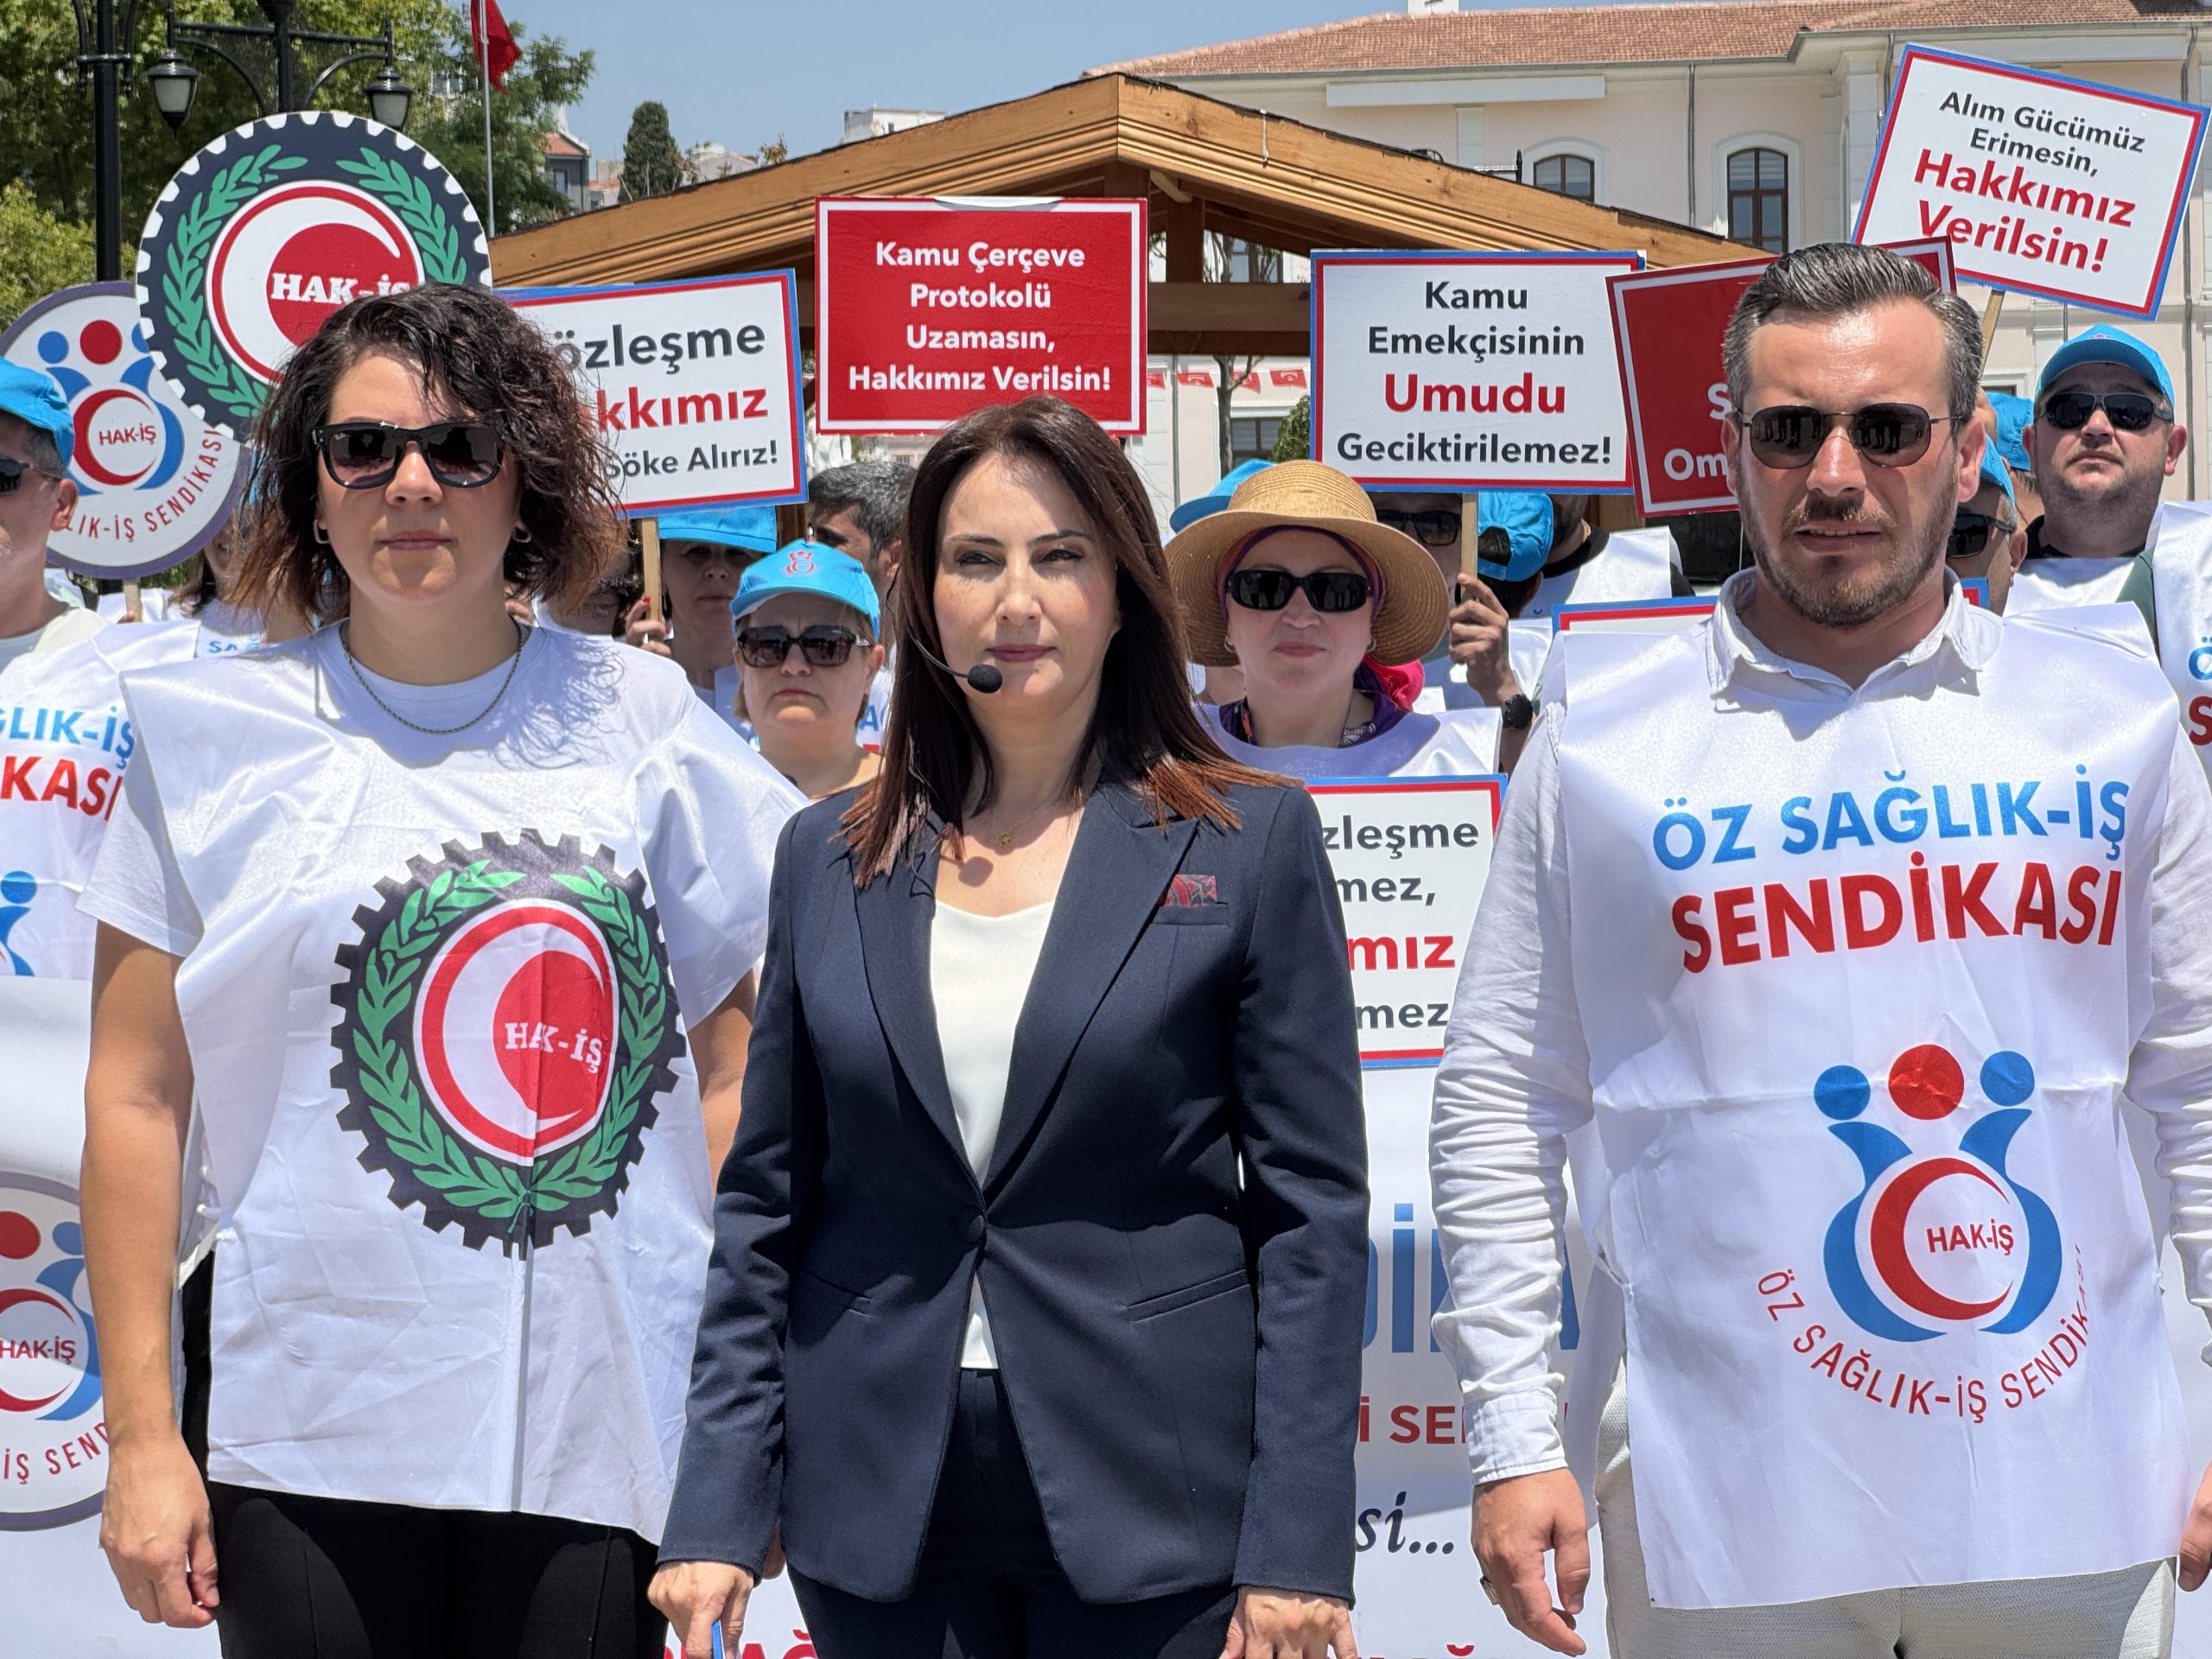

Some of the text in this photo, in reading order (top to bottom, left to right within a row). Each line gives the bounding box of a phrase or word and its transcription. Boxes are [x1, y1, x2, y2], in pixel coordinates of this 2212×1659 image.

[1939, 92, 2145, 153] Alım Gücümüz
[1970, 128, 2099, 177] Erimesin,
[1914, 149, 2136, 228] Hakkımız
[875, 241, 1086, 274] Kamu Çerçeve
[1919, 200, 2108, 273] Verilsin!
[910, 282, 1052, 309] Protokolü
[1424, 281, 1529, 310] Kamu
[554, 323, 766, 375] özleşme
[906, 325, 1056, 353] Uzamasın,
[1368, 324, 1585, 364] Emekçisinin
[849, 365, 1111, 391] Hakkımız Verilsin!
[1384, 372, 1567, 414] Umudu
[595, 385, 769, 433] kkımız
[99, 423, 157, 445] HAK-İŞ
[1337, 432, 1611, 466] Geciktirilemez!
[687, 439, 779, 472] Alırız!
[1323, 814, 1480, 860] zleşme
[1652, 764, 2130, 872] ÖZ SAĞLIK-İŞ
[1671, 850, 2122, 974] SENDİKASI
[1926, 1217, 2015, 1257] HAK-İŞ
[1758, 1268, 1806, 1323] ÖZ
[1792, 1323, 1988, 1425] SAĞLIK-İŞ
